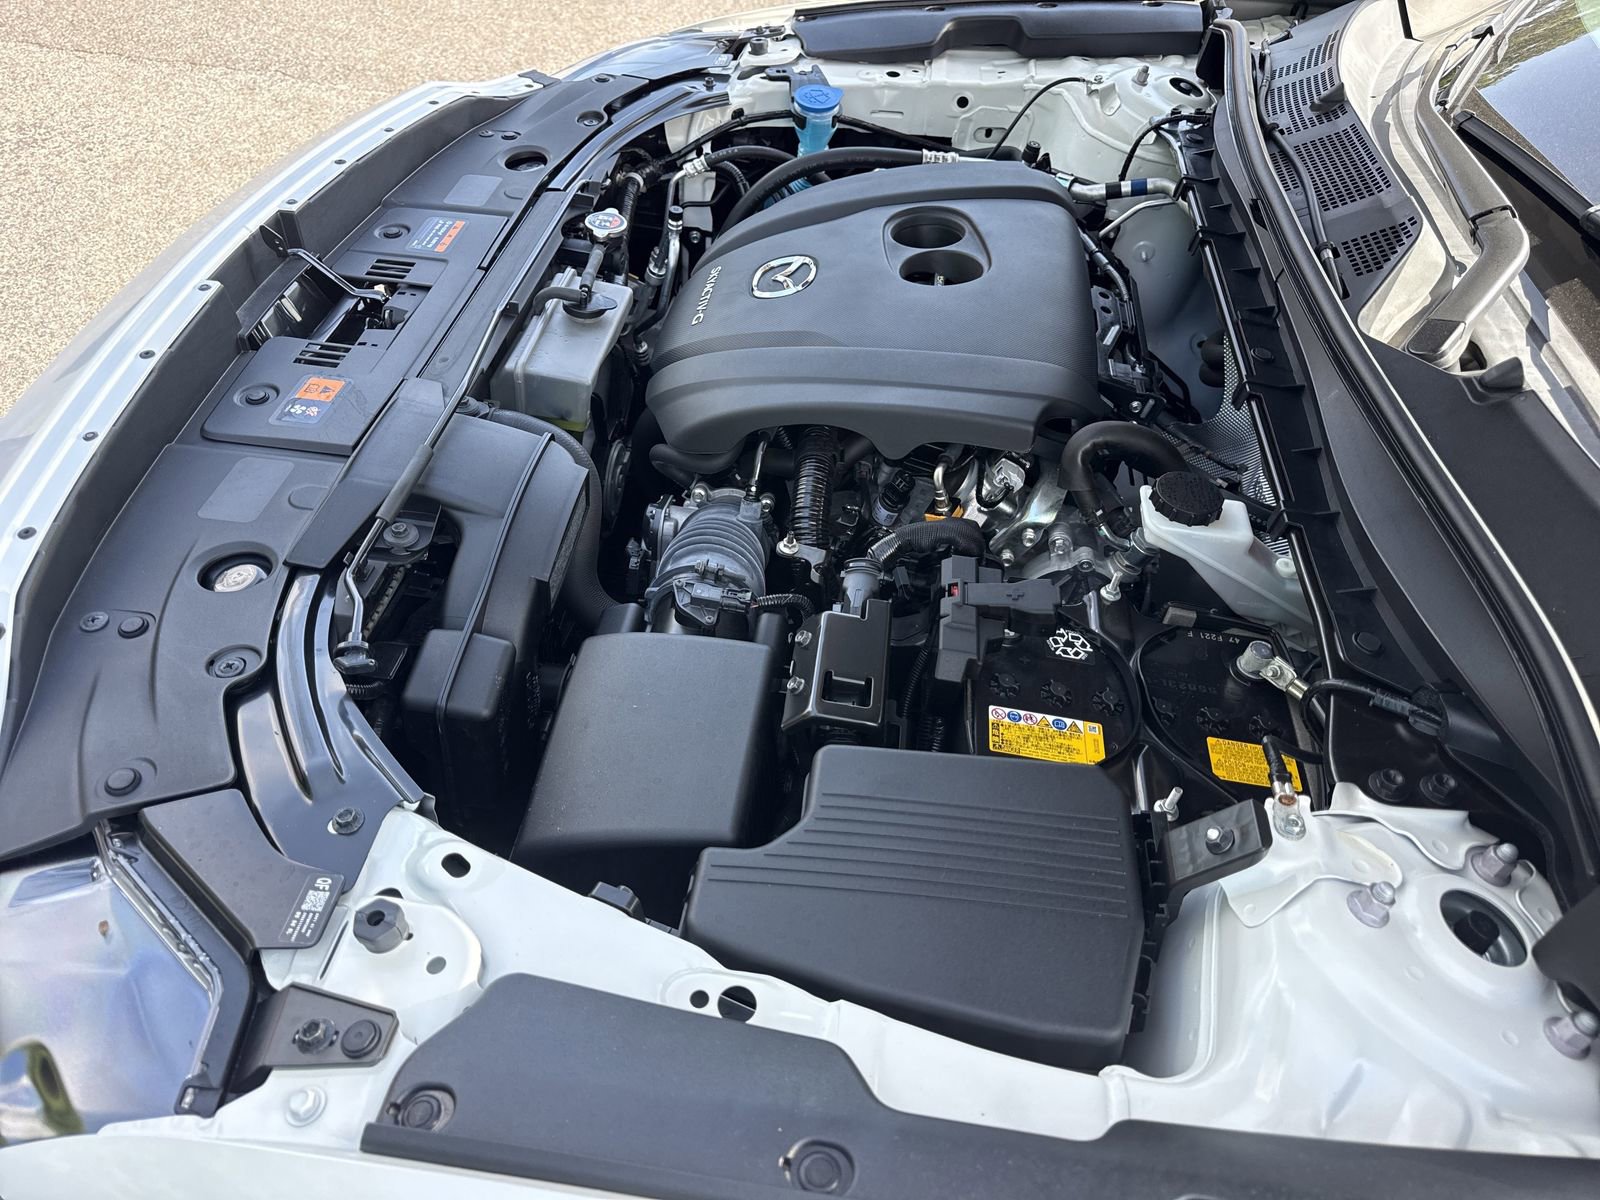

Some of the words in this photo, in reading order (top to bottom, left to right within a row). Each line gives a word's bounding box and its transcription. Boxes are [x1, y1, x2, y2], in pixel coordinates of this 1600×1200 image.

[691, 266, 722, 325] SKYACTIV-G
[1200, 632, 1223, 642] F221
[1222, 740, 1249, 748] DANGER
[314, 877, 332, 891] QF
